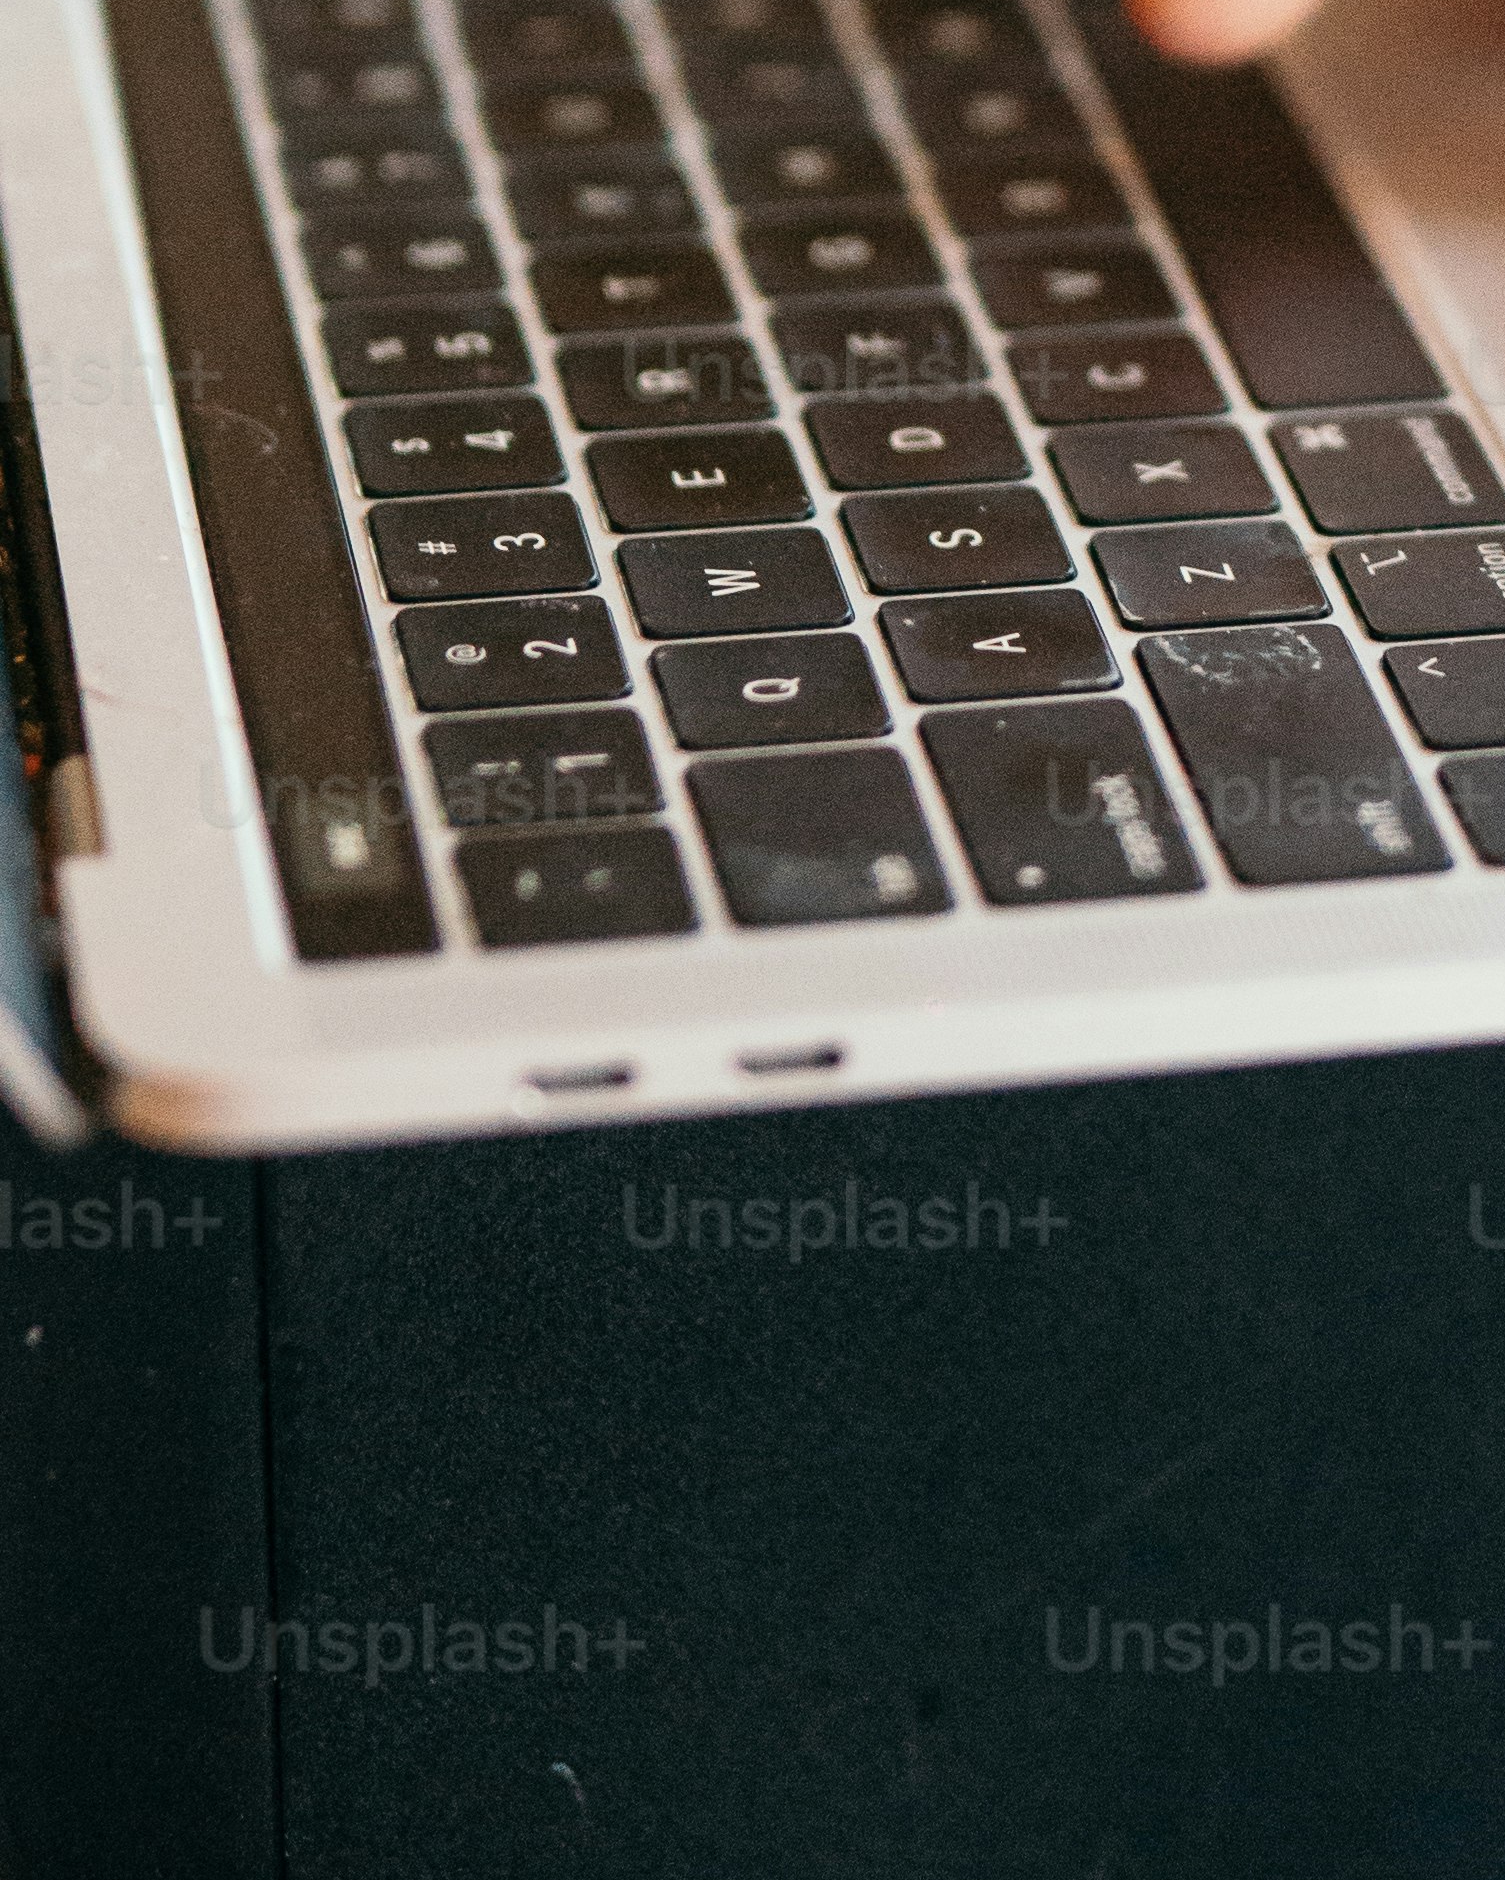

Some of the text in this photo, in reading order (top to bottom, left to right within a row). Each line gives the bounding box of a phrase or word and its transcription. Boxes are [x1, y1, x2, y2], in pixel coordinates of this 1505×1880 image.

[1088, 365, 1145, 388] C
[392, 438, 430, 453] $
[465, 430, 513, 450] 4
[890, 427, 944, 450] D
[672, 469, 726, 488] E
[1135, 461, 1187, 482] X
[419, 541, 456, 554] #
[493, 532, 546, 551] 3
[929, 528, 983, 549] S
[705, 568, 760, 596] W
[1180, 563, 1235, 583] Z
[523, 638, 577, 658] 2
[973, 632, 1026, 653] A
[445, 644, 487, 665] @
[743, 678, 800, 702] Q
